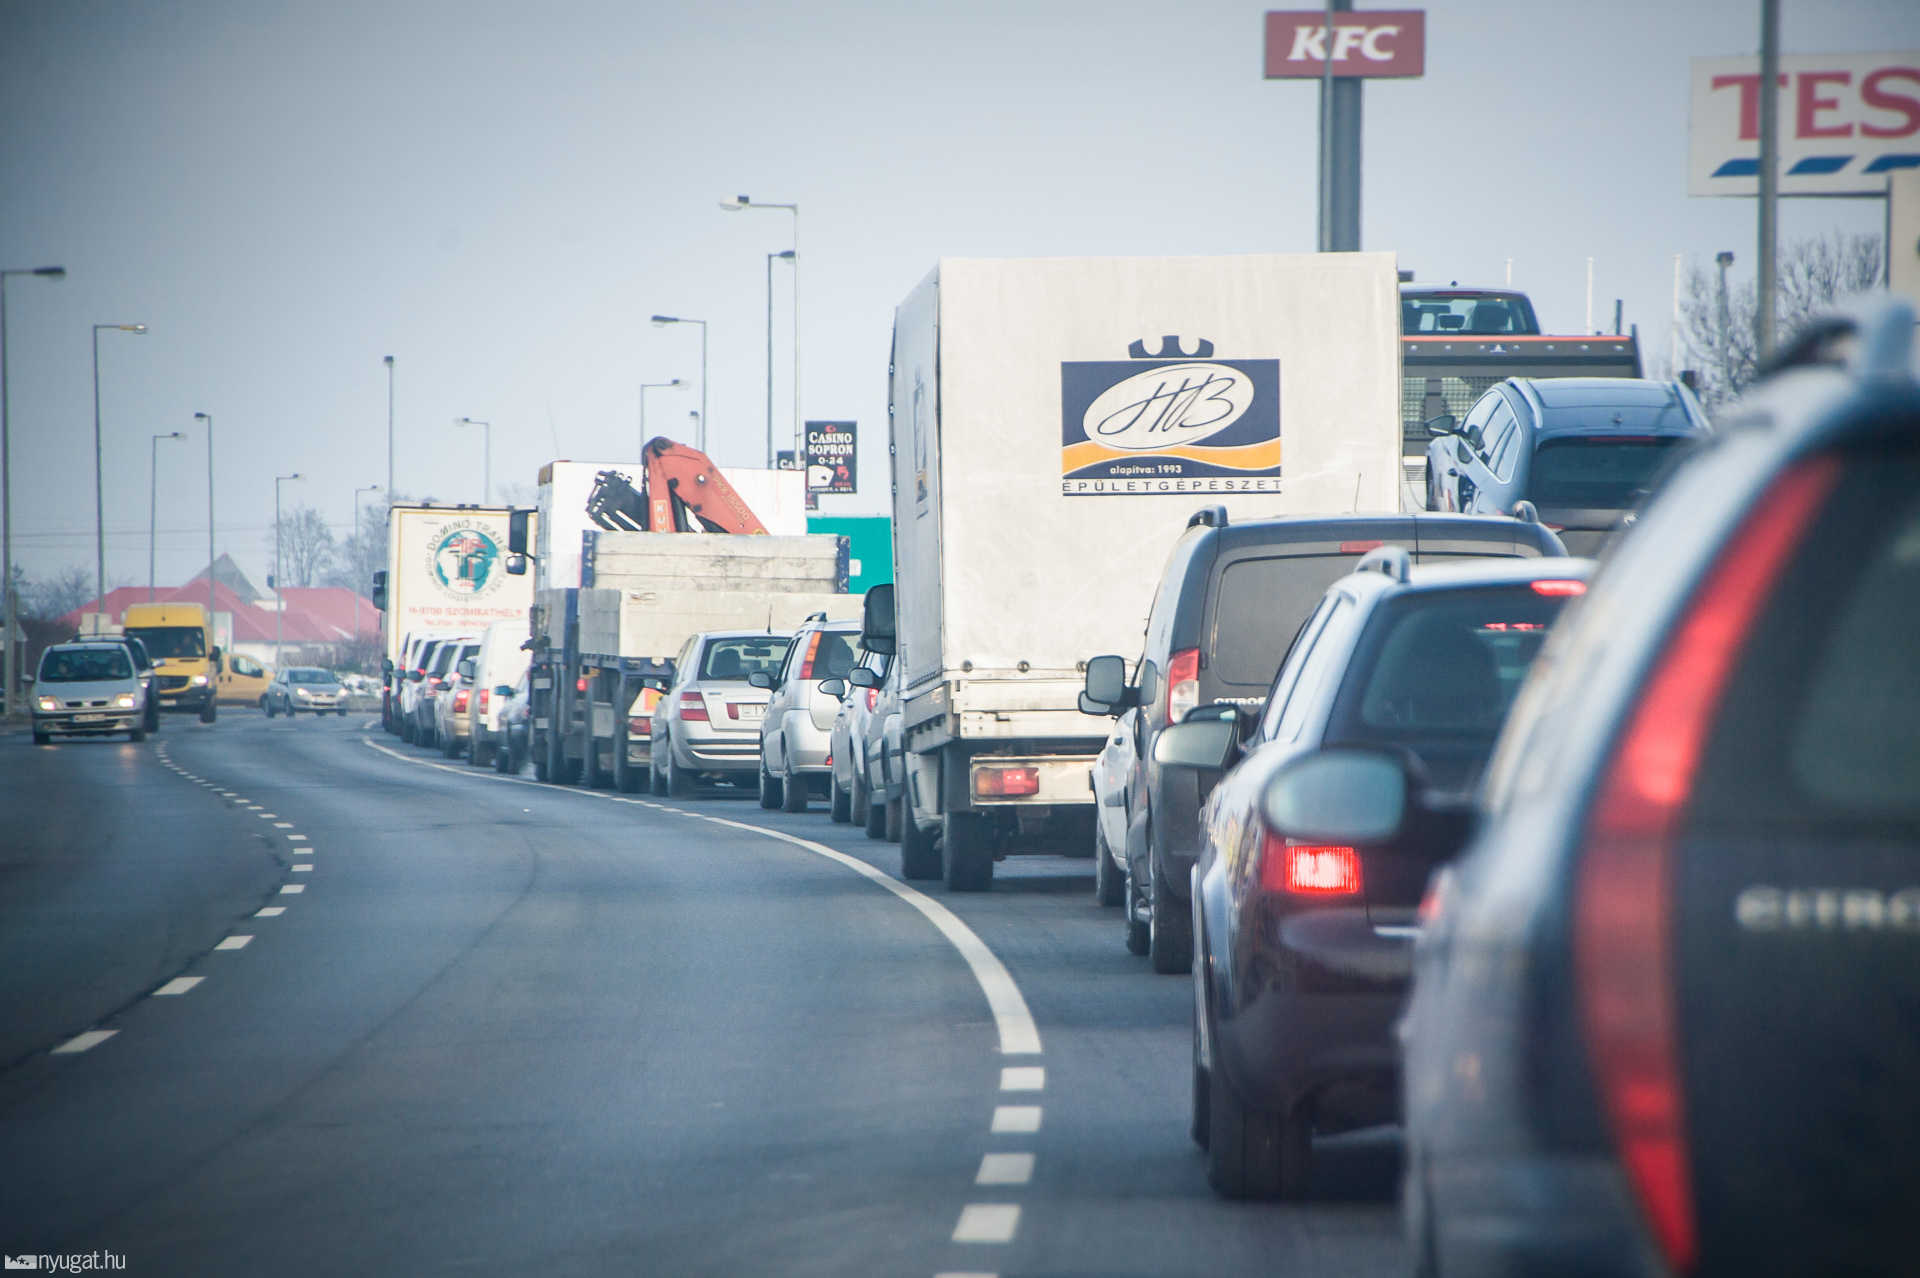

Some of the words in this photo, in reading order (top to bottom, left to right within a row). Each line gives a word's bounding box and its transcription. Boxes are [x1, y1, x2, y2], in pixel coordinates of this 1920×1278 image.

[1287, 25, 1402, 61] KFC
[809, 432, 853, 444] CASINO
[808, 444, 853, 455] SOPRON
[1157, 464, 1182, 474] 1993
[1062, 478, 1281, 492] ÉPÜLETGÉPÉSZET
[426, 519, 471, 551] DOMINO
